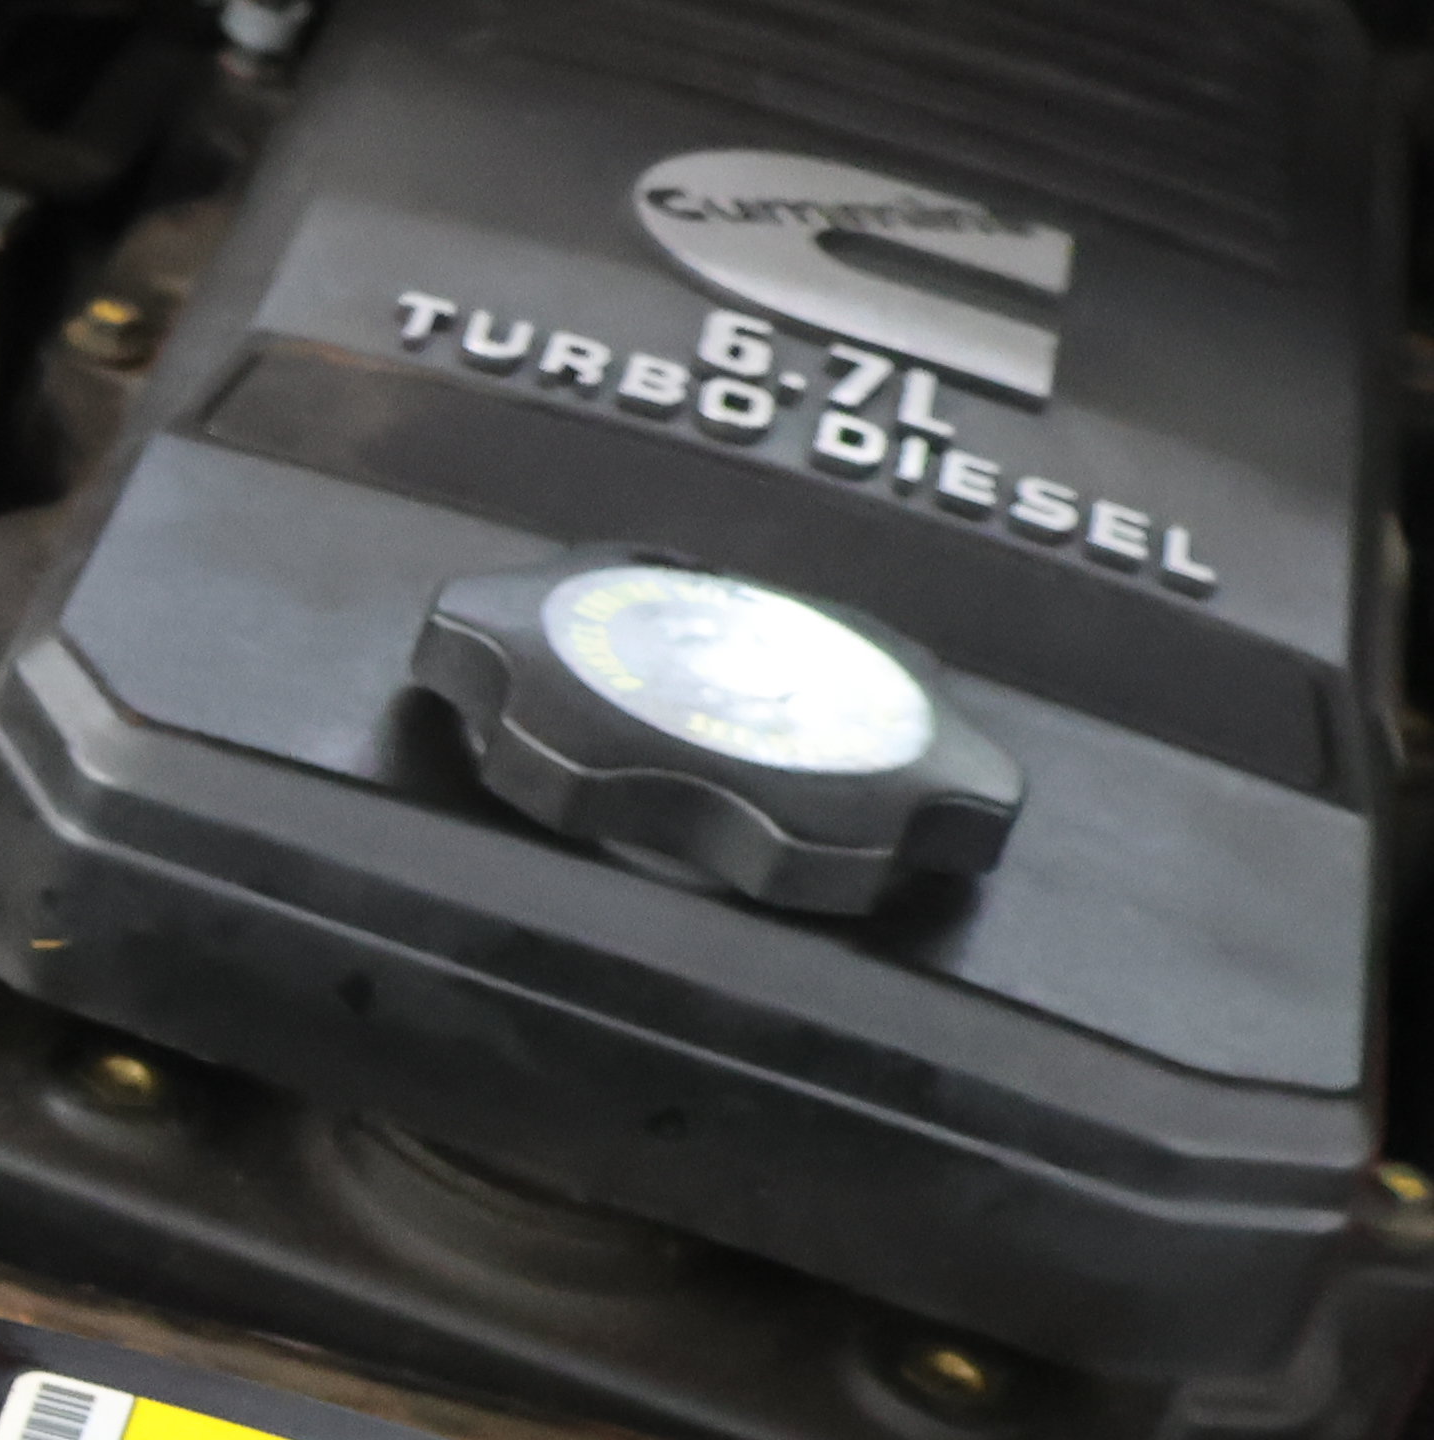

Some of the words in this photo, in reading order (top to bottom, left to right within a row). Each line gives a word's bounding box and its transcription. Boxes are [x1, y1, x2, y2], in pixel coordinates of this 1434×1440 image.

[396, 290, 775, 438] TURBO
[811, 410, 1218, 596] DIESEL
[697, 308, 956, 438] 6.7L
